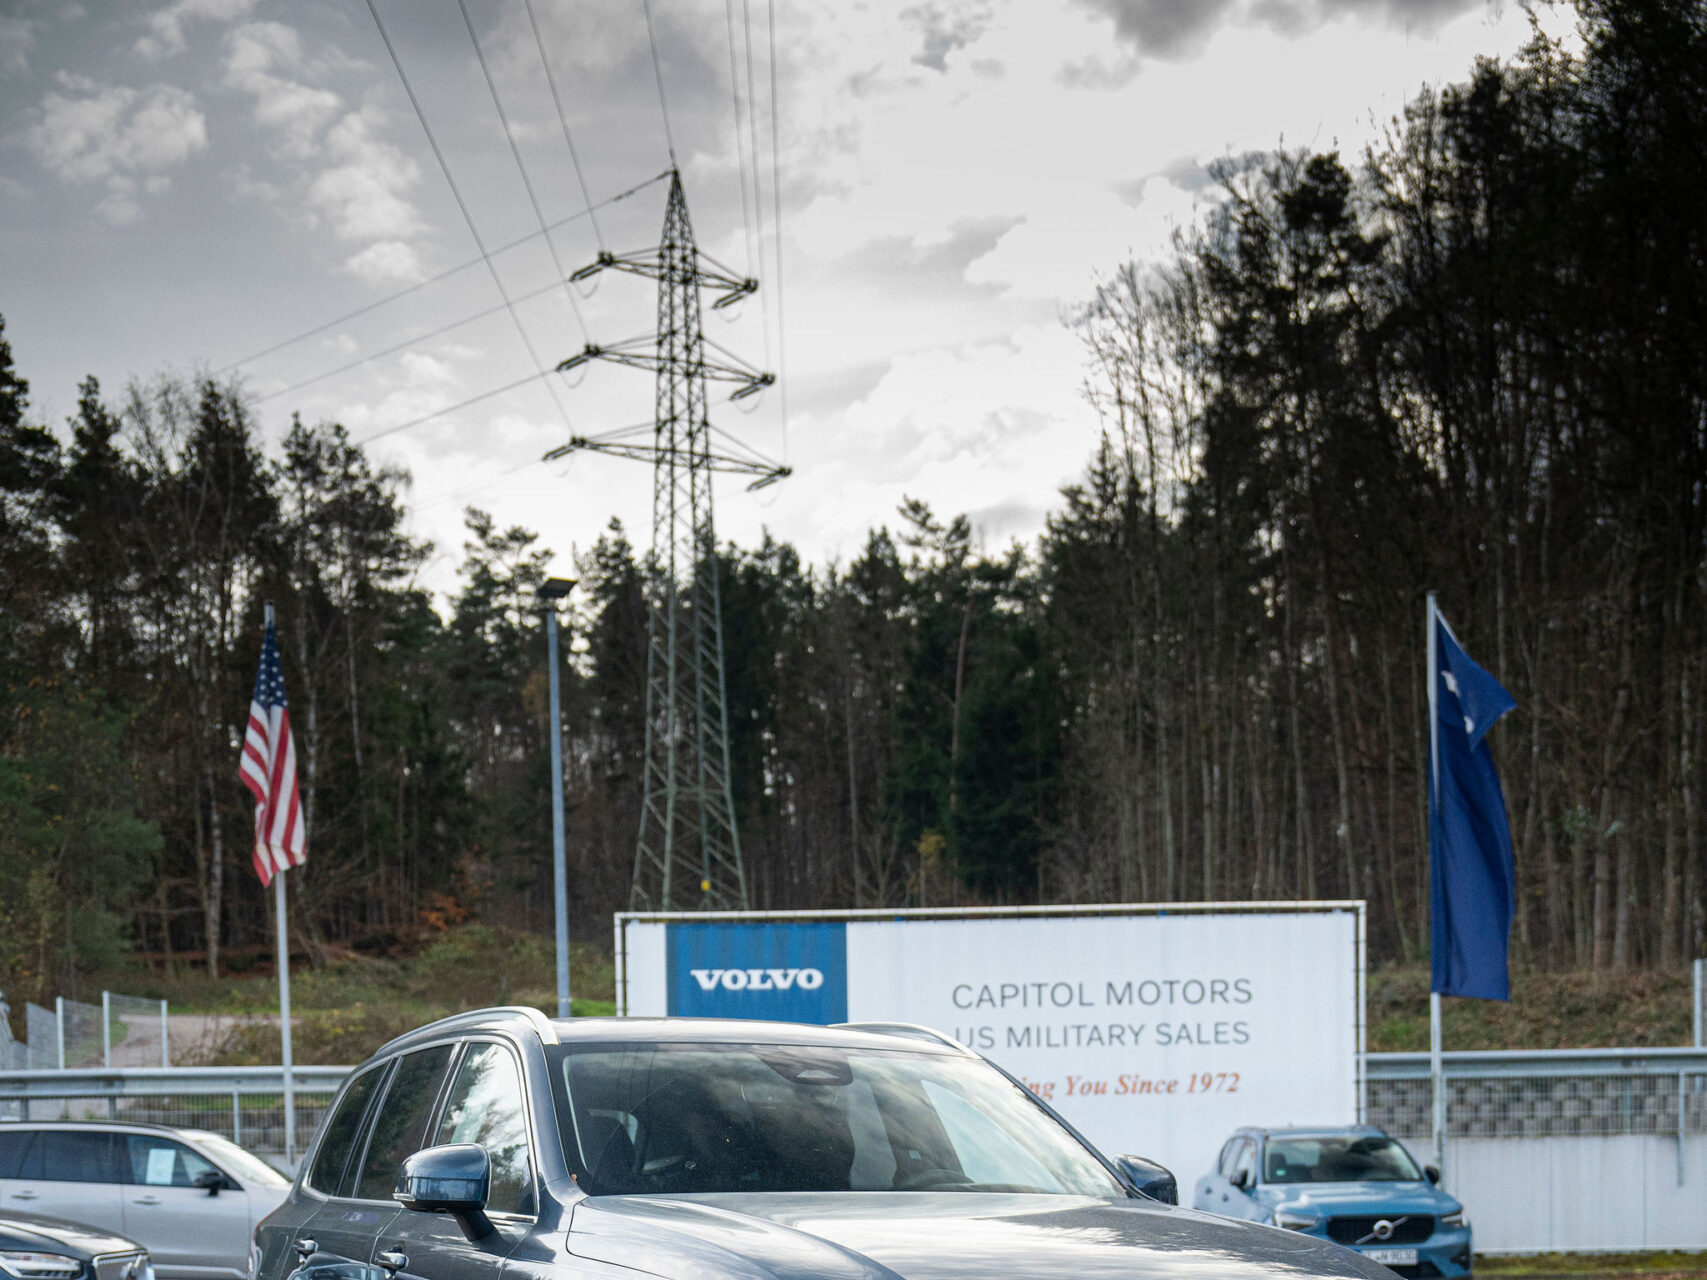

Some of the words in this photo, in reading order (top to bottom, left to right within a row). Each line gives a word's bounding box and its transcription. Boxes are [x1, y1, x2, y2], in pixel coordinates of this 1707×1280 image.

[690, 968, 824, 990] VOLVO
[952, 982, 1094, 1009] CAPITOL
[1106, 979, 1252, 1005] MOTORS
[955, 1026, 995, 1049] US
[1007, 1023, 1145, 1048] MILITARY
[1156, 1021, 1251, 1046] SALES
[1066, 1075, 1107, 1096] You
[1114, 1074, 1178, 1095] Since
[1187, 1072, 1240, 1093] 1972
